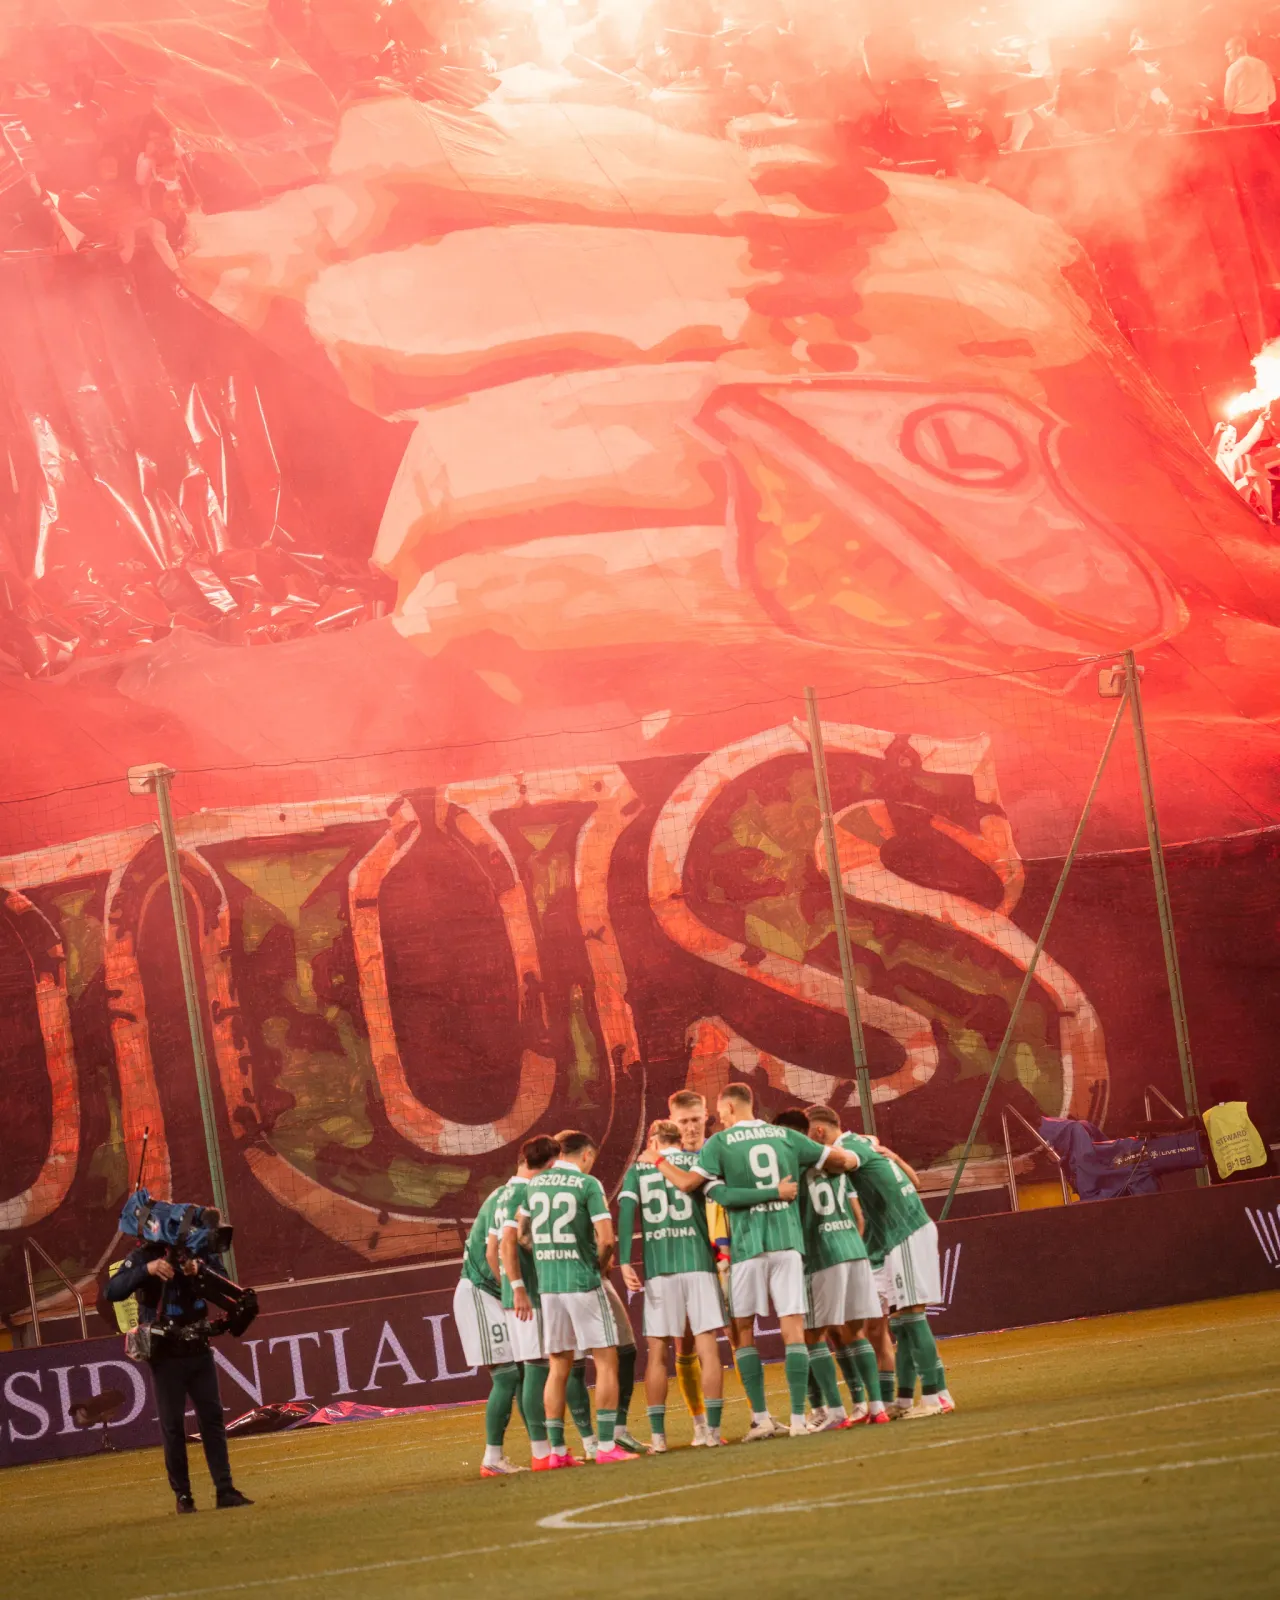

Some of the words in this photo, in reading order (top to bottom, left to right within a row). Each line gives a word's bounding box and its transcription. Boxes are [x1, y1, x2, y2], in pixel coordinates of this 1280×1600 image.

[727, 1126, 787, 1145] ADAMSKI
[1215, 1129, 1248, 1147] STEWARD
[749, 1143, 780, 1189] 9
[639, 1172, 693, 1224] 53
[529, 1191, 578, 1244] 22
[645, 1226, 697, 1242] FORTUNA
[535, 1249, 580, 1261] ORTUNA
[491, 1322, 510, 1344] 91
[0, 1313, 479, 1444] SIDNTIAL
